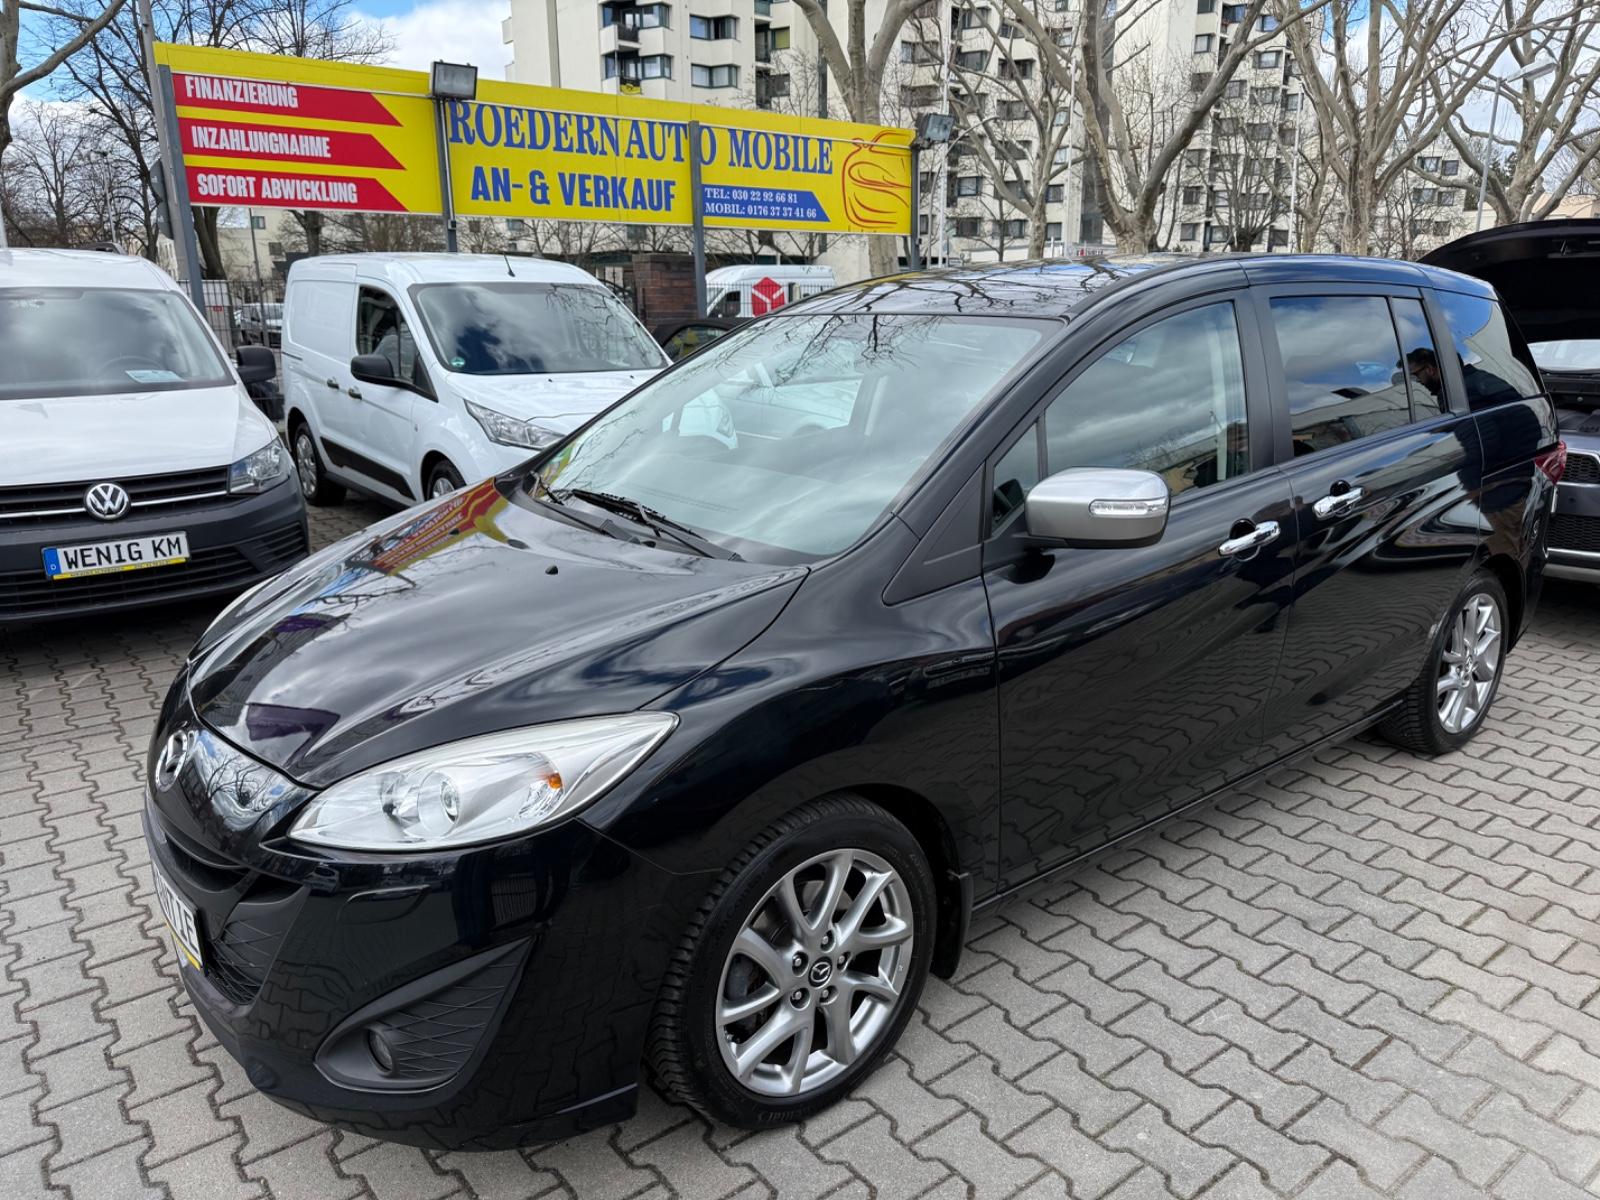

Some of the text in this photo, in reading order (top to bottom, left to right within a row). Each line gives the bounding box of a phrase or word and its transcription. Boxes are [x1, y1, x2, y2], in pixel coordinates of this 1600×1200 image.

[184, 75, 299, 108] FINANZIERUNG
[191, 125, 332, 158] INZAHLUNGNAHME
[448, 100, 620, 157] ROEDERN
[728, 128, 833, 174] MOBILE
[197, 173, 358, 204] SOFORT ABWICKLUNG
[471, 165, 676, 212] AN- & VERKAUF
[704, 187, 798, 204] TEL: 030 22 92 66 81
[705, 202, 817, 218] MOBIL: 0176 37 37 41 66
[63, 536, 183, 570] WENIG KM
